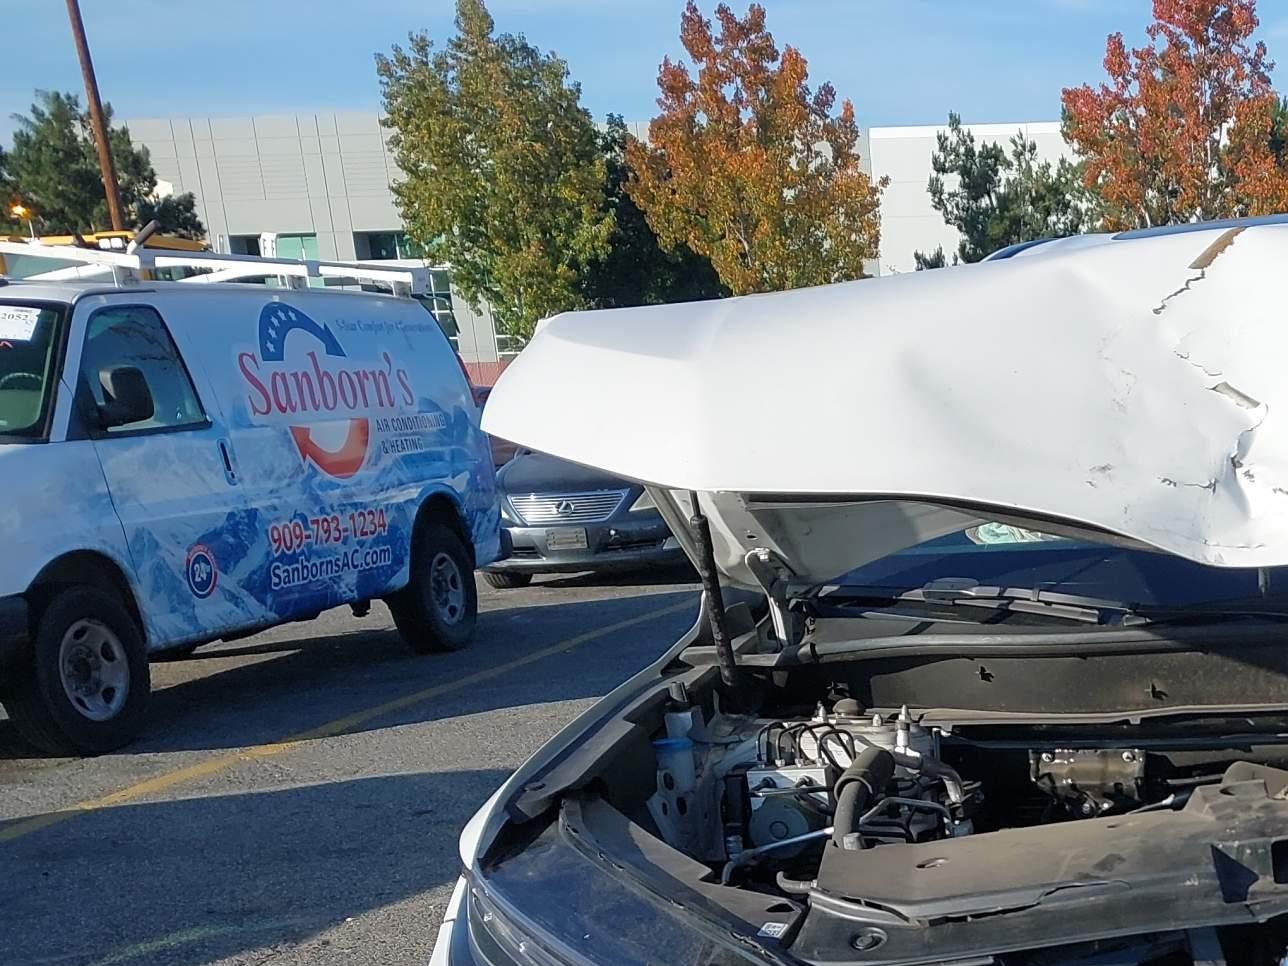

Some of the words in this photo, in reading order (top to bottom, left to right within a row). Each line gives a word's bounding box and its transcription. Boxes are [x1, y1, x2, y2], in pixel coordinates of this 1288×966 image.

[238, 351, 414, 416] Sanborn's
[376, 417, 390, 432] AIR
[391, 414, 445, 431] CONDITIONING
[381, 440, 389, 454] &
[390, 437, 424, 454] HEATING
[270, 507, 387, 555] 909-793-1234
[271, 547, 391, 588] SanbornsAC.com
